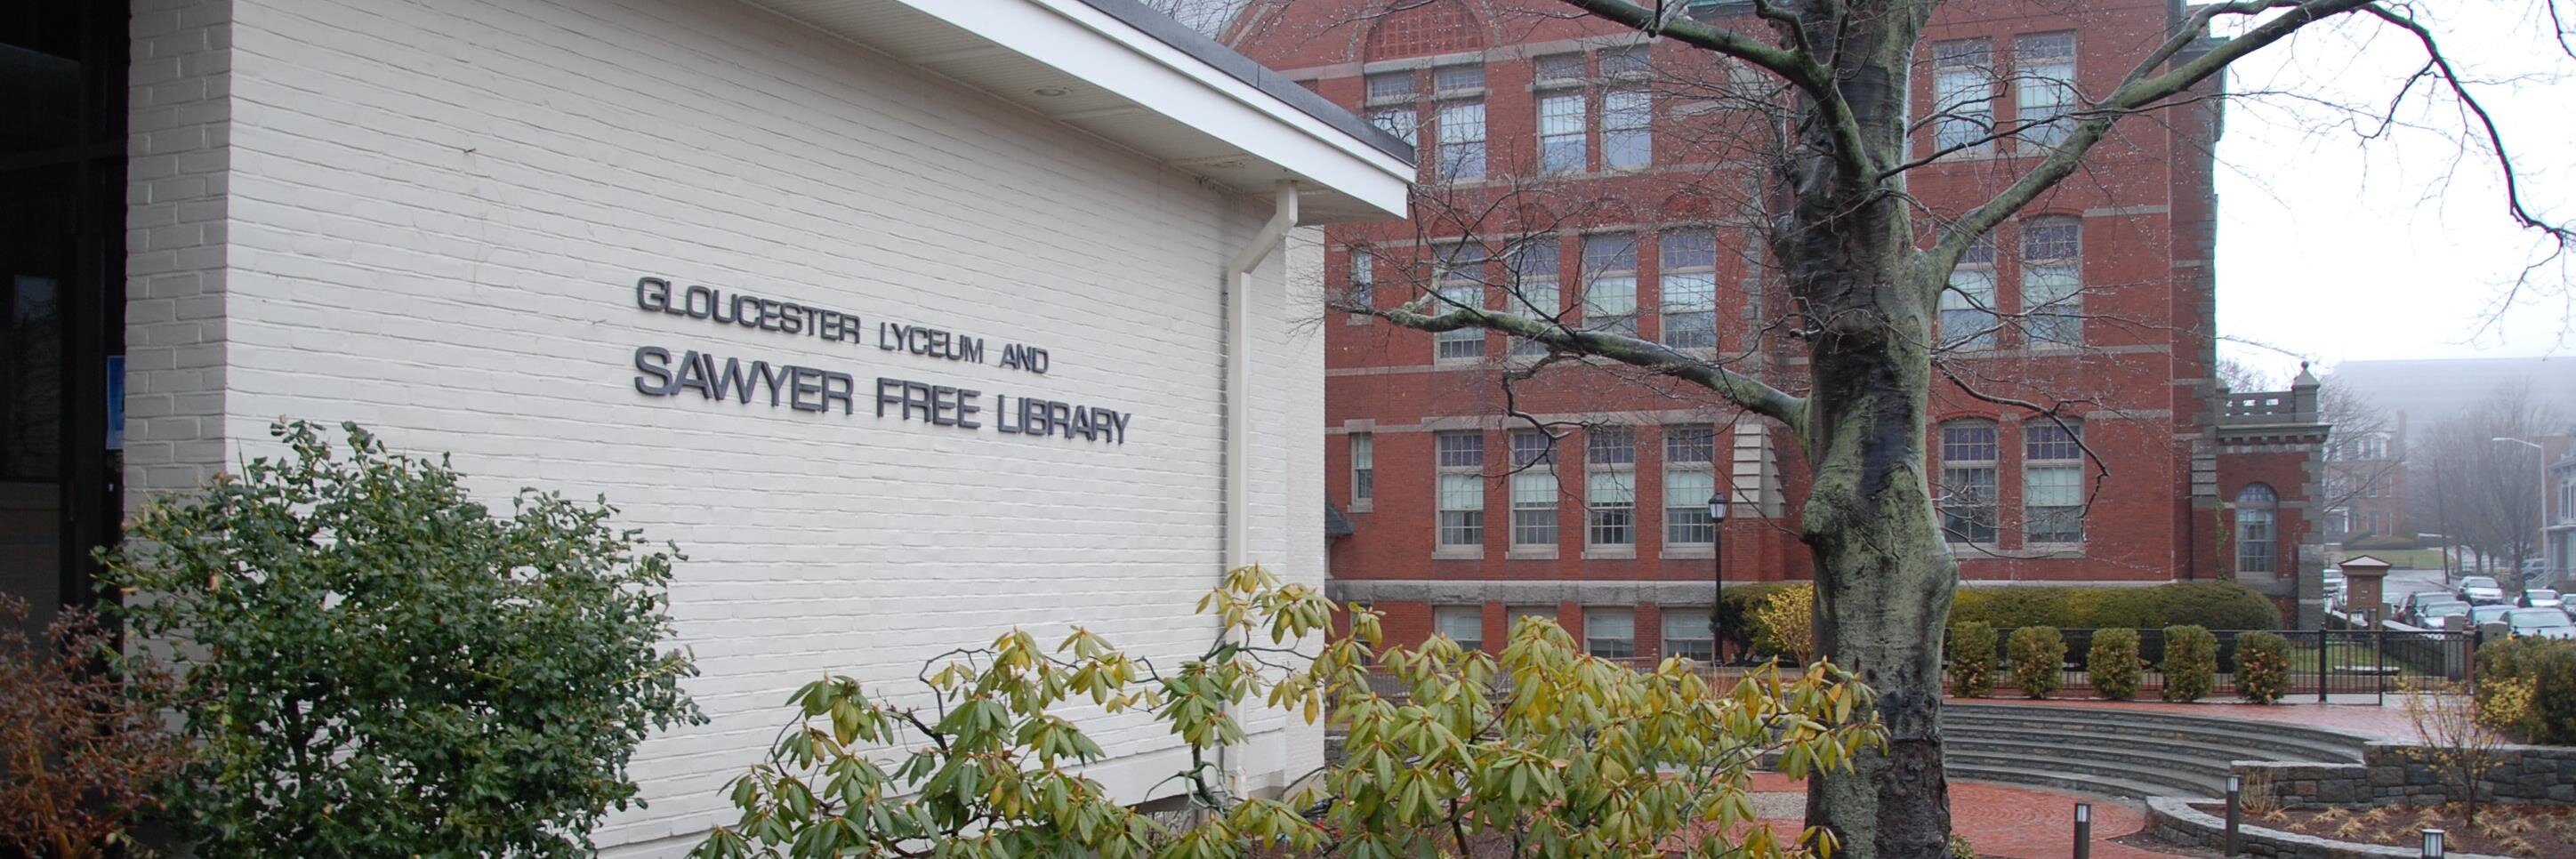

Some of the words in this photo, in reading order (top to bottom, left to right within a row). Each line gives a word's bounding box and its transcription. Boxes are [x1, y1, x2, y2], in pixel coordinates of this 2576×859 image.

[637, 277, 860, 344] GLOUCESTER
[880, 323, 983, 363] LYCEUM
[999, 344, 1048, 373] AND
[635, 347, 853, 415] SAWYER
[877, 378, 980, 430] FREE
[998, 395, 1130, 445] LIBRARY
